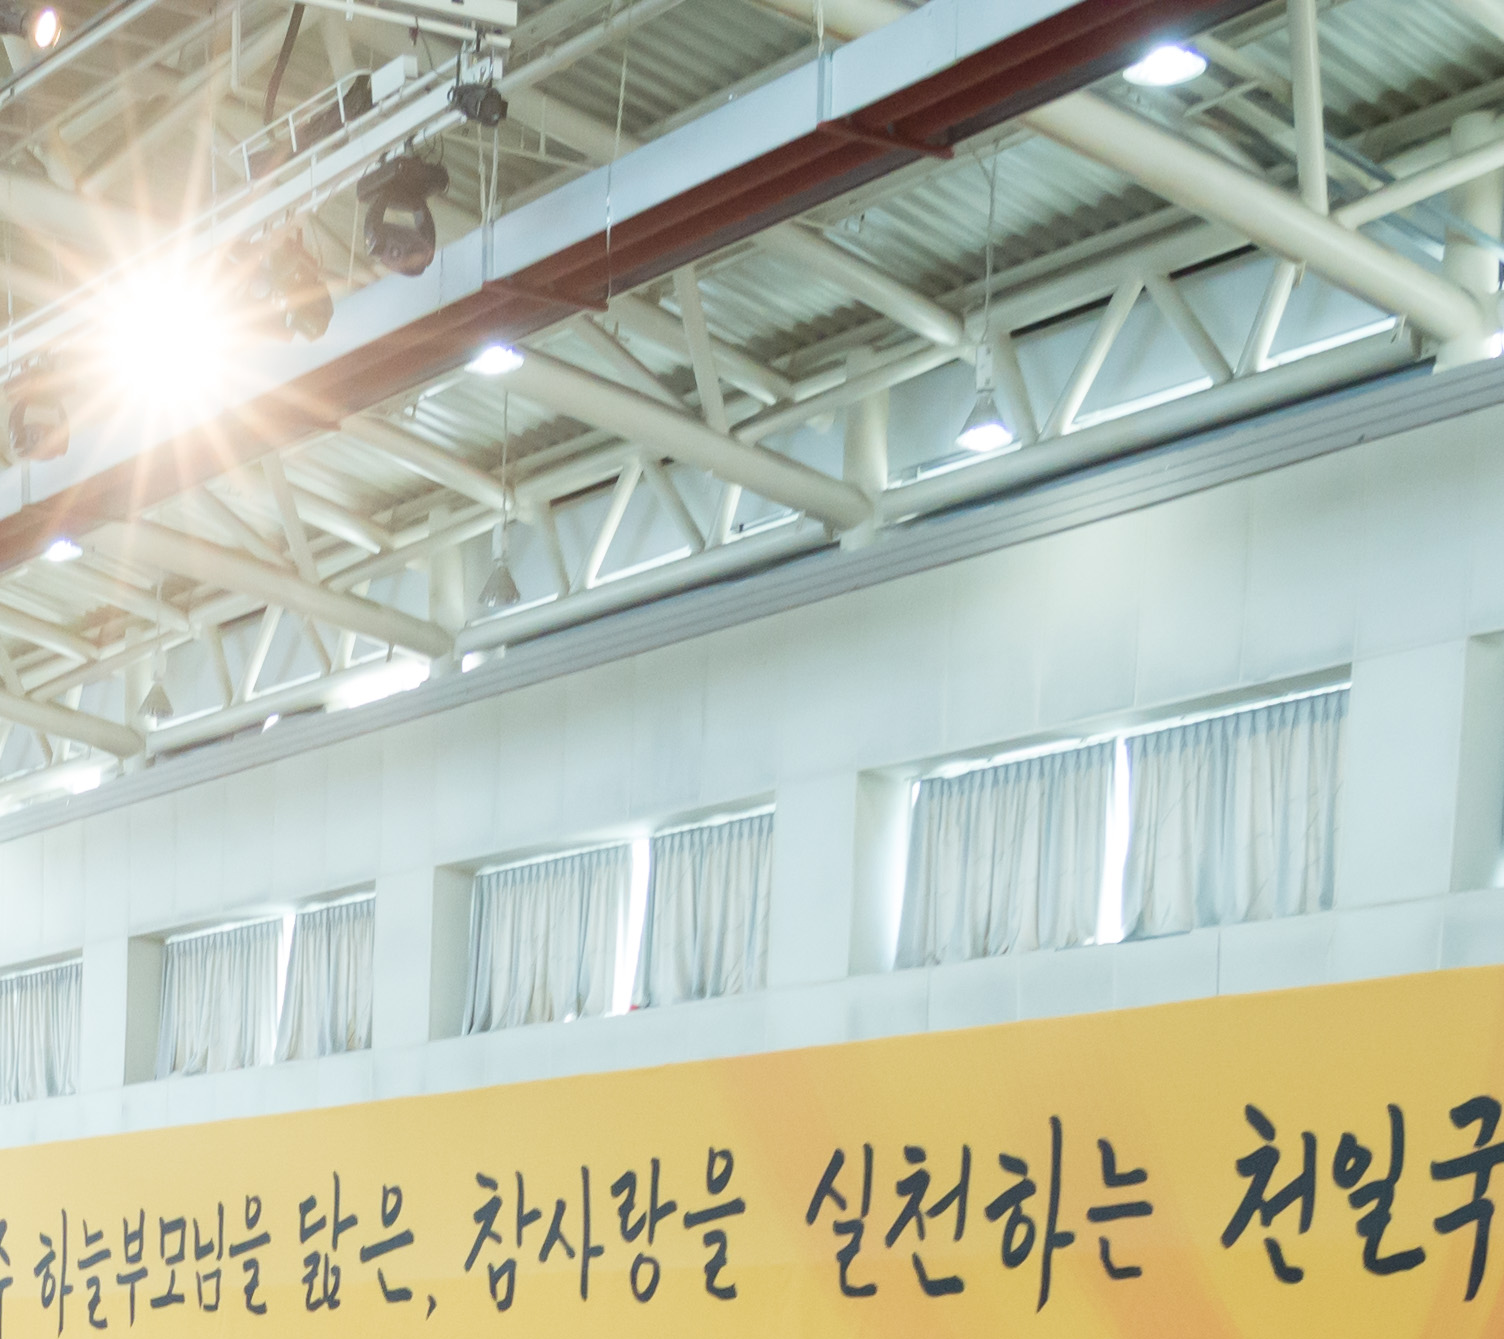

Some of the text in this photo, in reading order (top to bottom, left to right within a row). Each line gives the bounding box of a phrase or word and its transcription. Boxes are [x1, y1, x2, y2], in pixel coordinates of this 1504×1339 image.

[34, 1193, 272, 1337] 하늘부모님을
[298, 1170, 437, 1321] 닮은,
[464, 1145, 746, 1313] 참사랑을
[805, 1115, 1154, 1314] 실천하는
